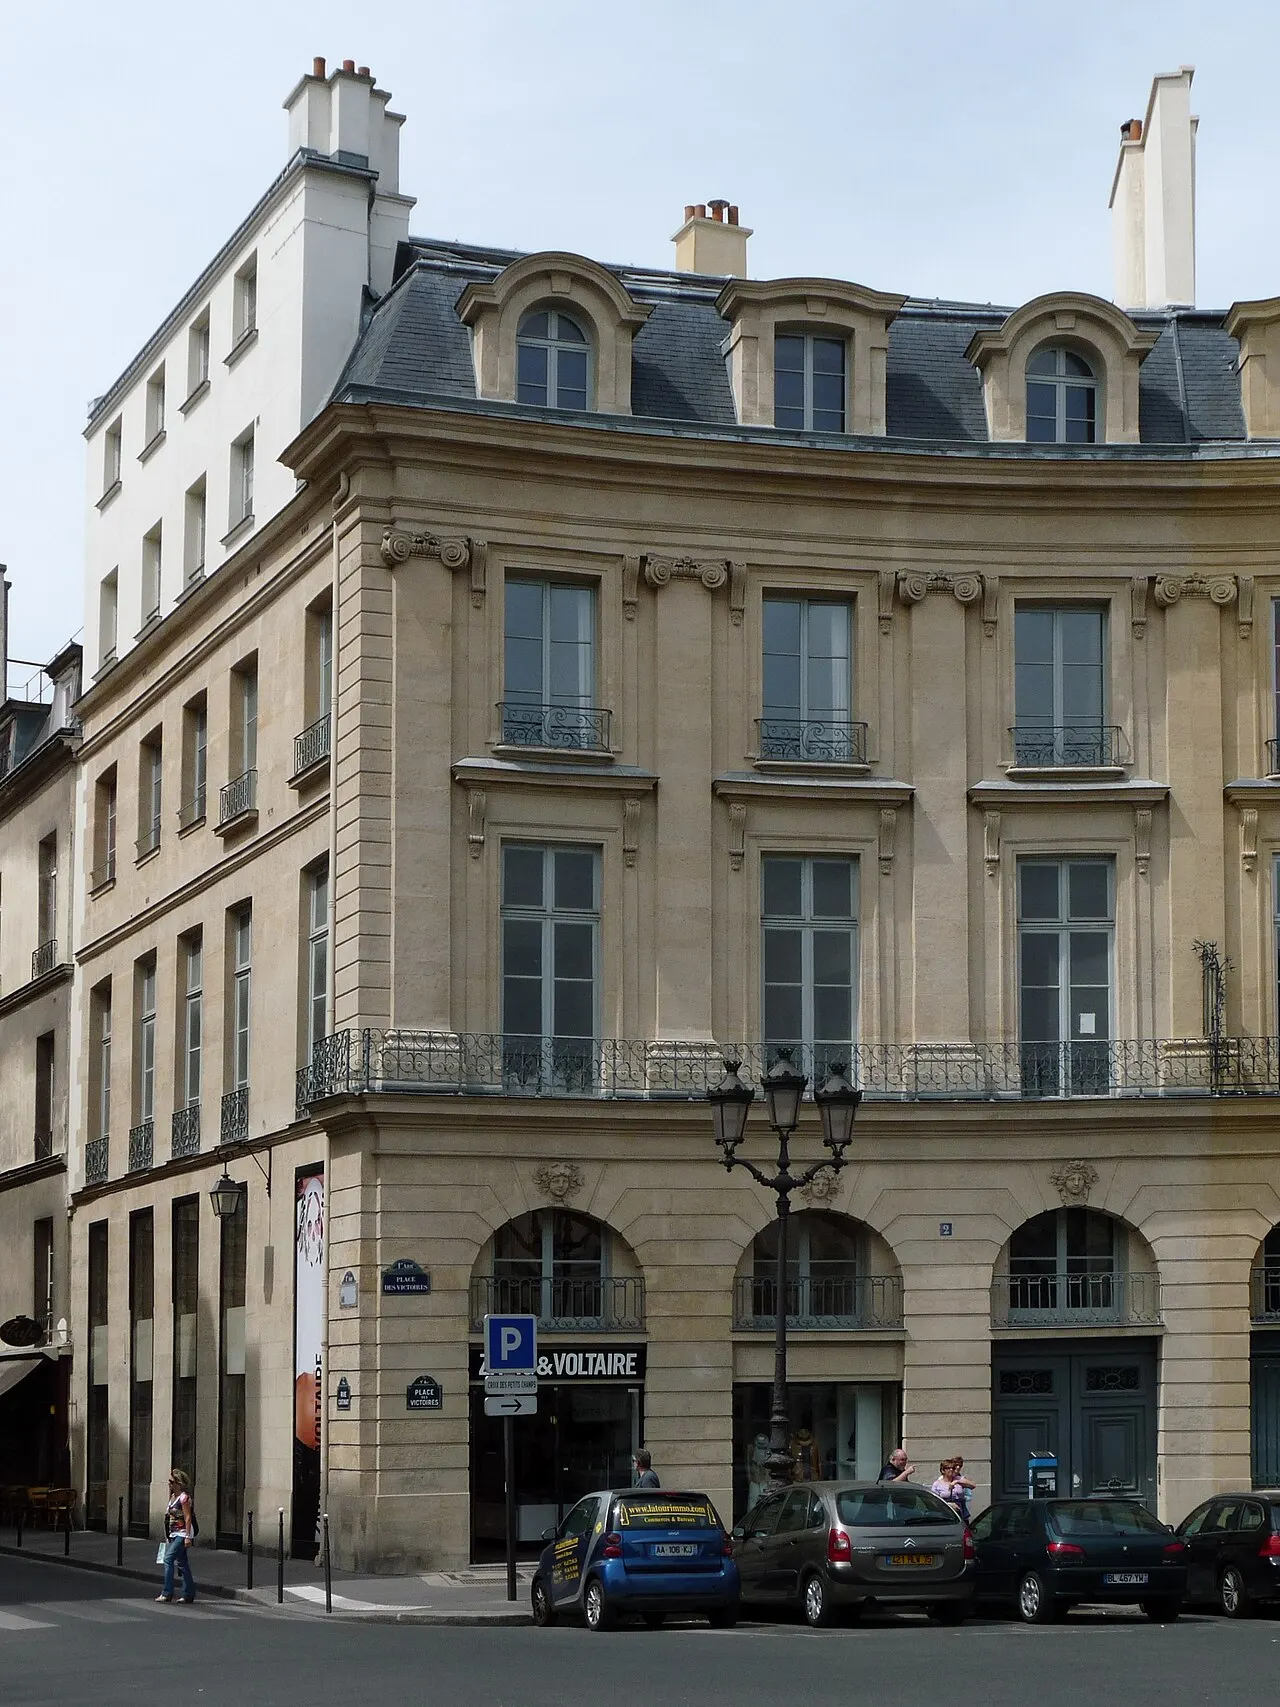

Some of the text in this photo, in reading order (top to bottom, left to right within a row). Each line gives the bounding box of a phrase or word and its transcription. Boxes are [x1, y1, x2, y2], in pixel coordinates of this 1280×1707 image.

[943, 1225, 949, 1234] 2
[501, 1327, 521, 1360] P
[488, 1380, 536, 1389] CROIX DES PETITS CHAMPS
[415, 1388, 434, 1396] PLACE
[629, 1504, 706, 1514] www.latourimmo.com
